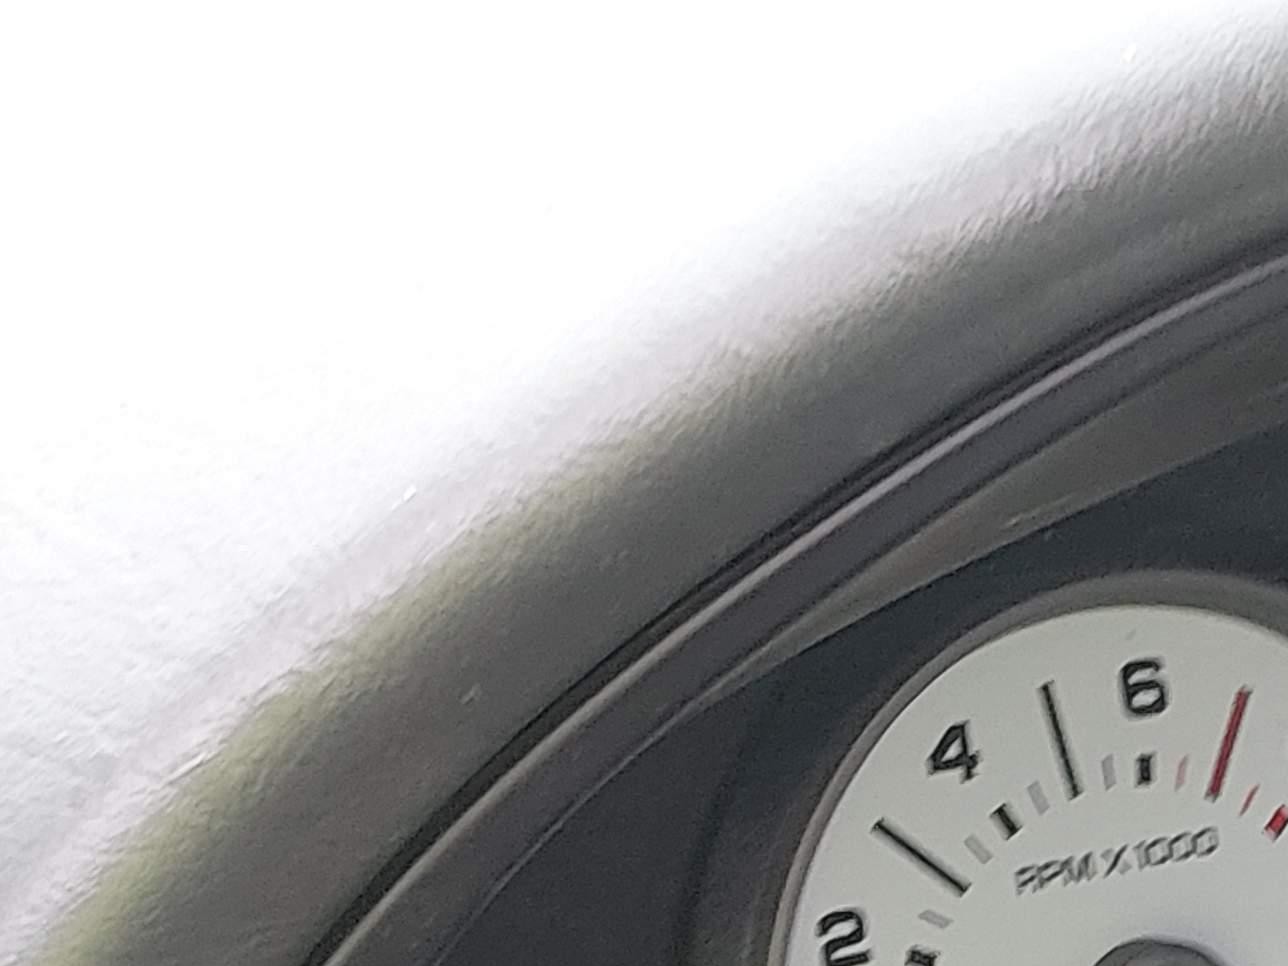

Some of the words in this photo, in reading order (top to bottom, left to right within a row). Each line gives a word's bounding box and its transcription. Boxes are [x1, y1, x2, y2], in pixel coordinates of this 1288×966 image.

[1120, 657, 1167, 716] 6
[929, 721, 980, 782] 4
[1014, 851, 1098, 896] RPM
[1134, 825, 1220, 871] 1000
